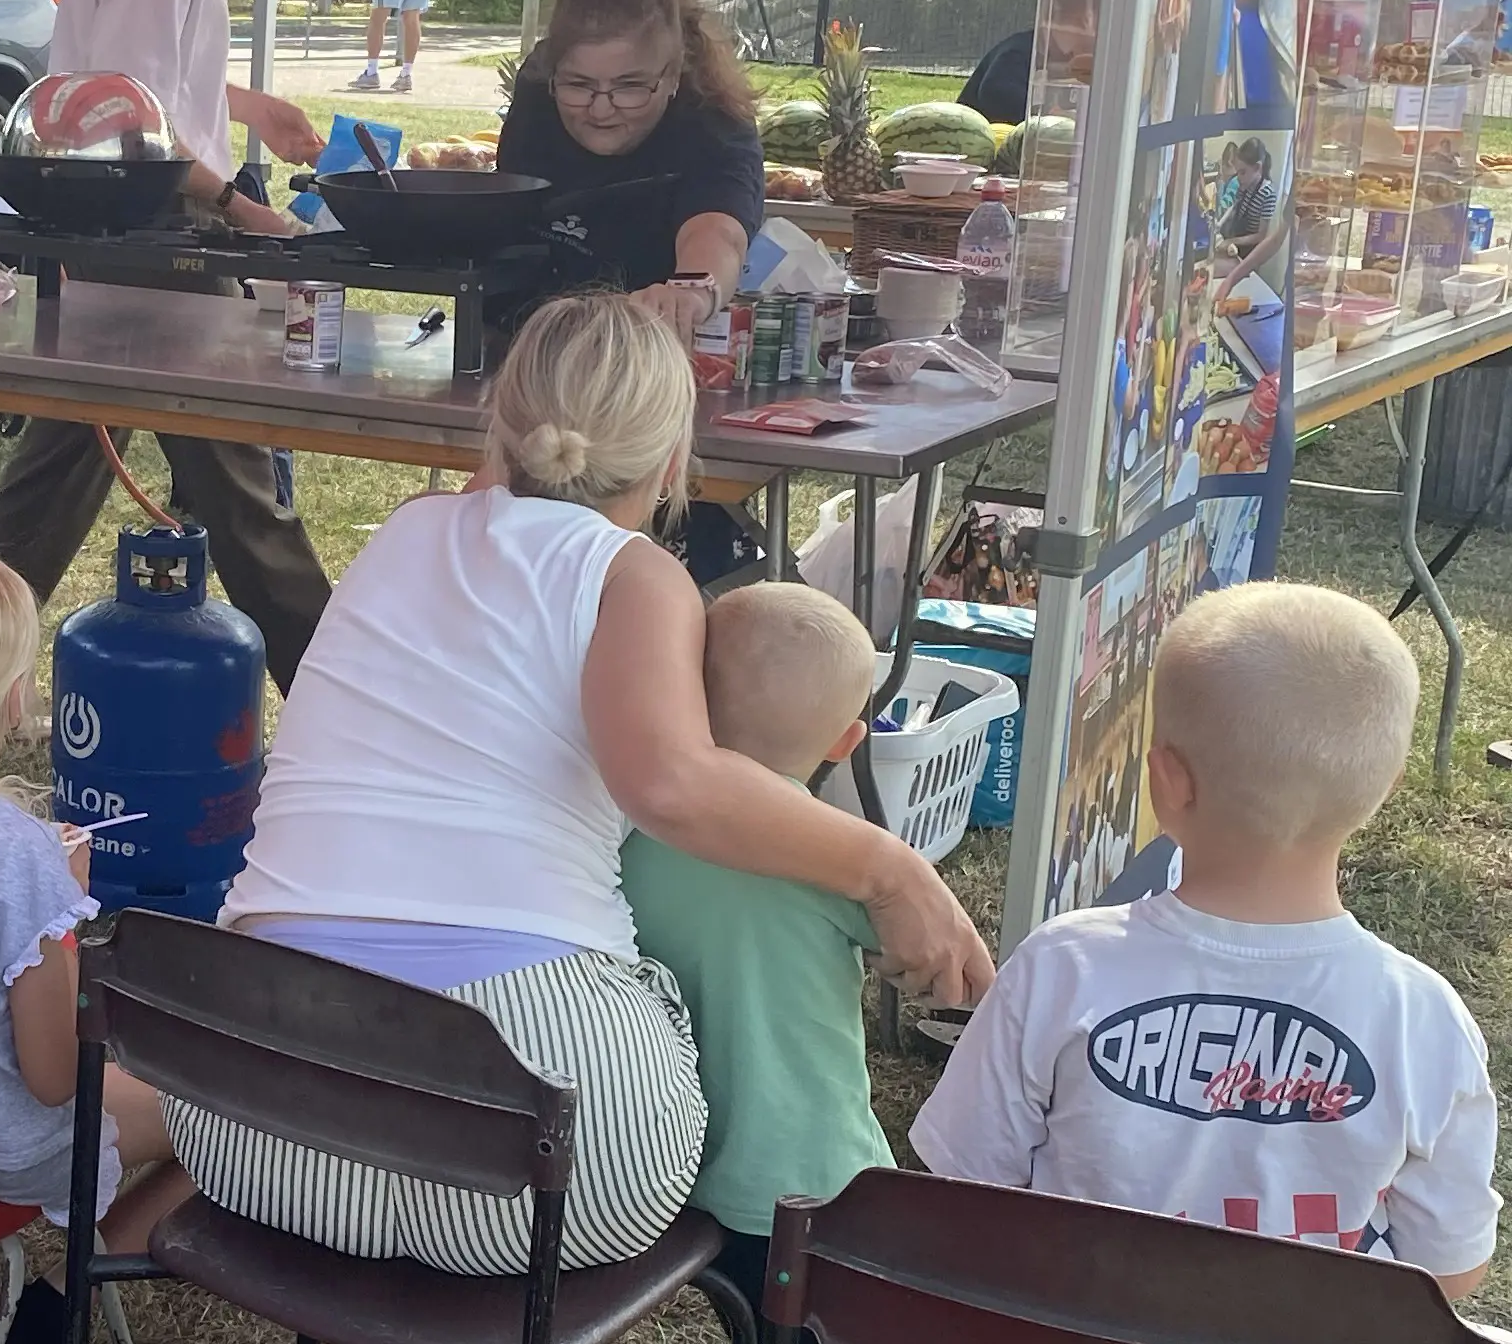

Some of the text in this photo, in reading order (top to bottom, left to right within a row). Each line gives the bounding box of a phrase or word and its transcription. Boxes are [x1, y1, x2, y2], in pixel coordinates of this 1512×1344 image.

[172, 257, 205, 272] VIPER
[962, 254, 1002, 268] evian
[992, 716, 1016, 803] deliveroo
[88, 835, 136, 857] tane
[1092, 1002, 1362, 1120] ORIGINAL
[1203, 1062, 1357, 1123] Racing
